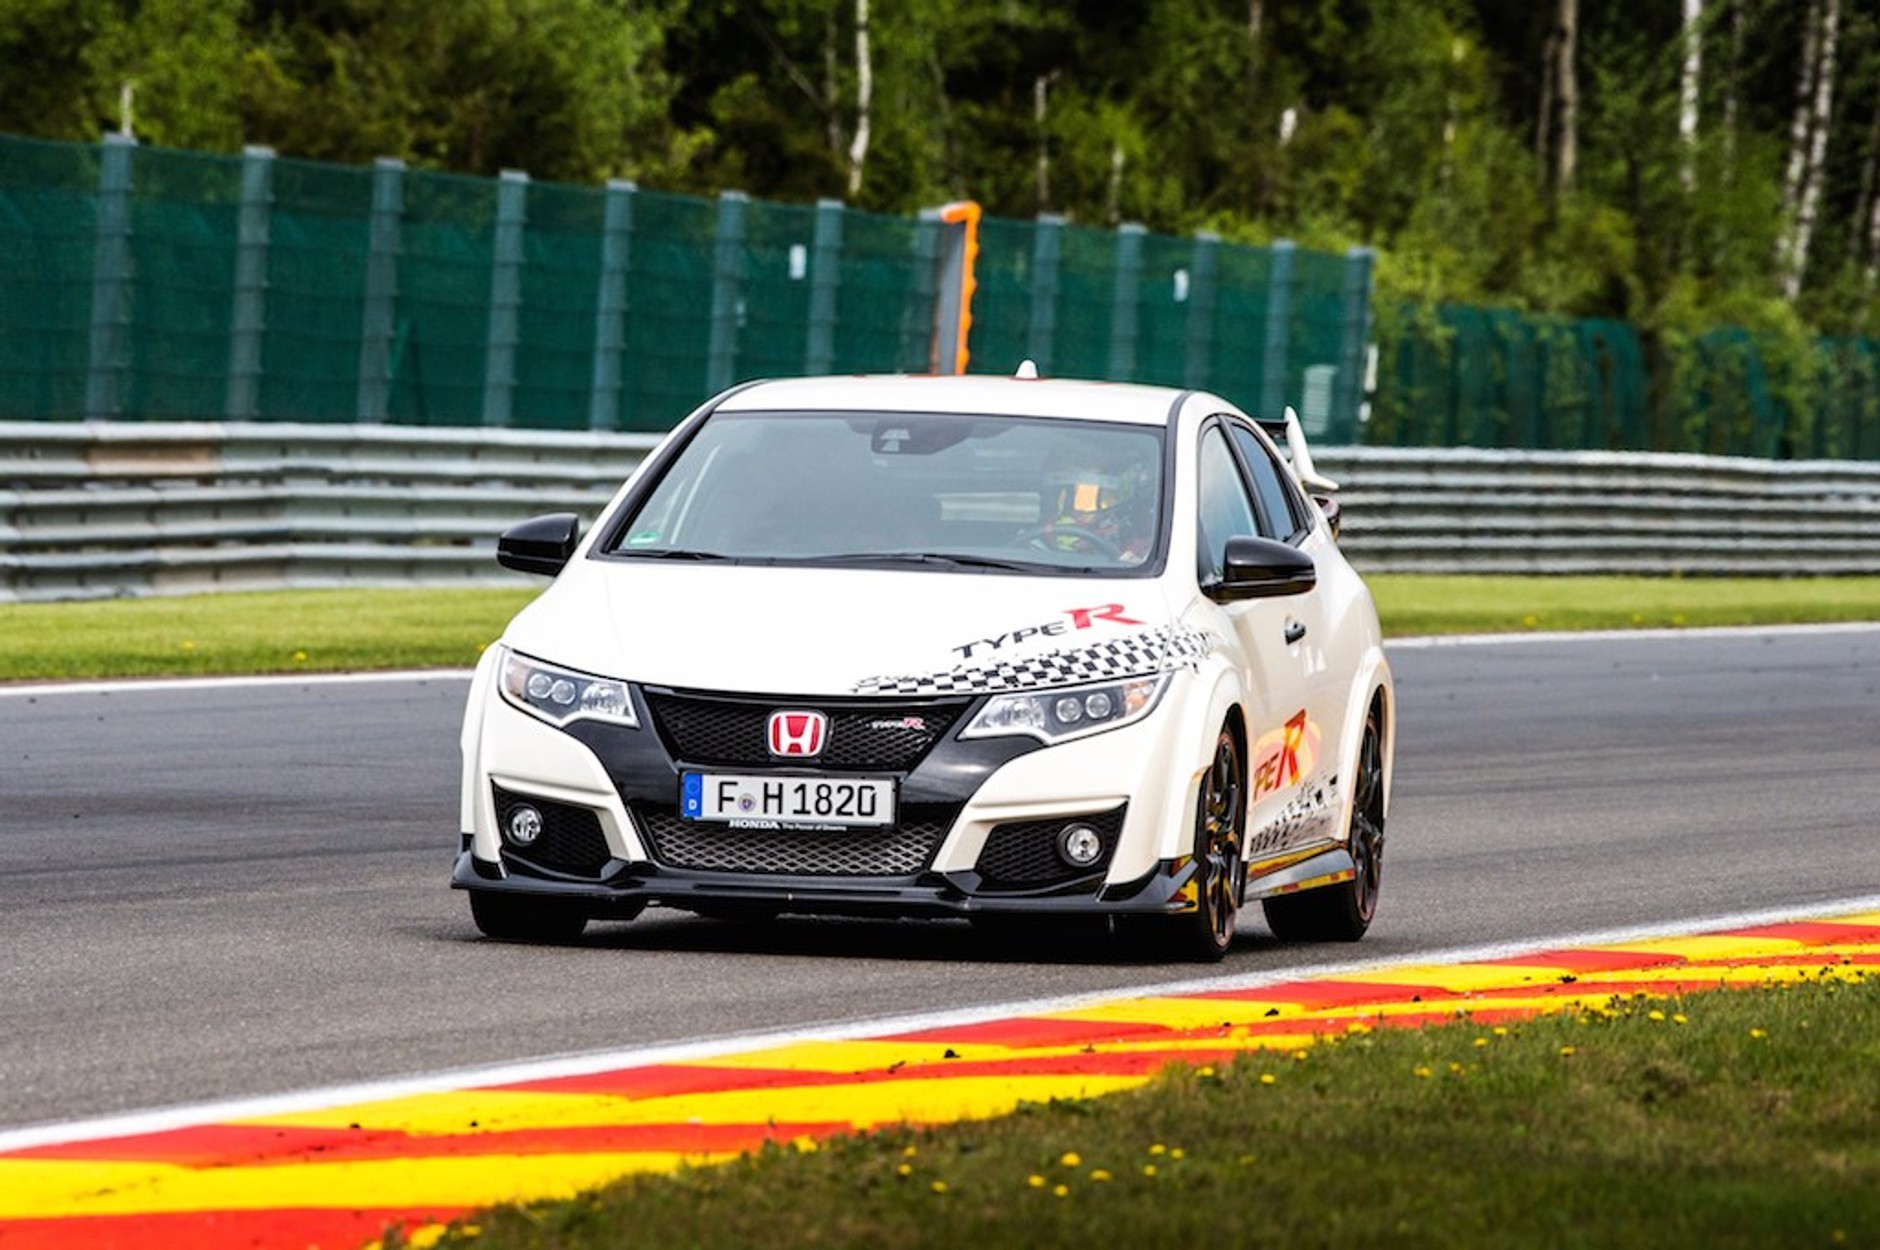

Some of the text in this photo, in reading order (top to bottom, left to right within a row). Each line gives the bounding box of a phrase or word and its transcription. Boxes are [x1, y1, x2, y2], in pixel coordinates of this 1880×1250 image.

[952, 603, 1146, 659] TYPE R
[688, 799, 697, 810] D
[728, 819, 780, 830] HONDA
